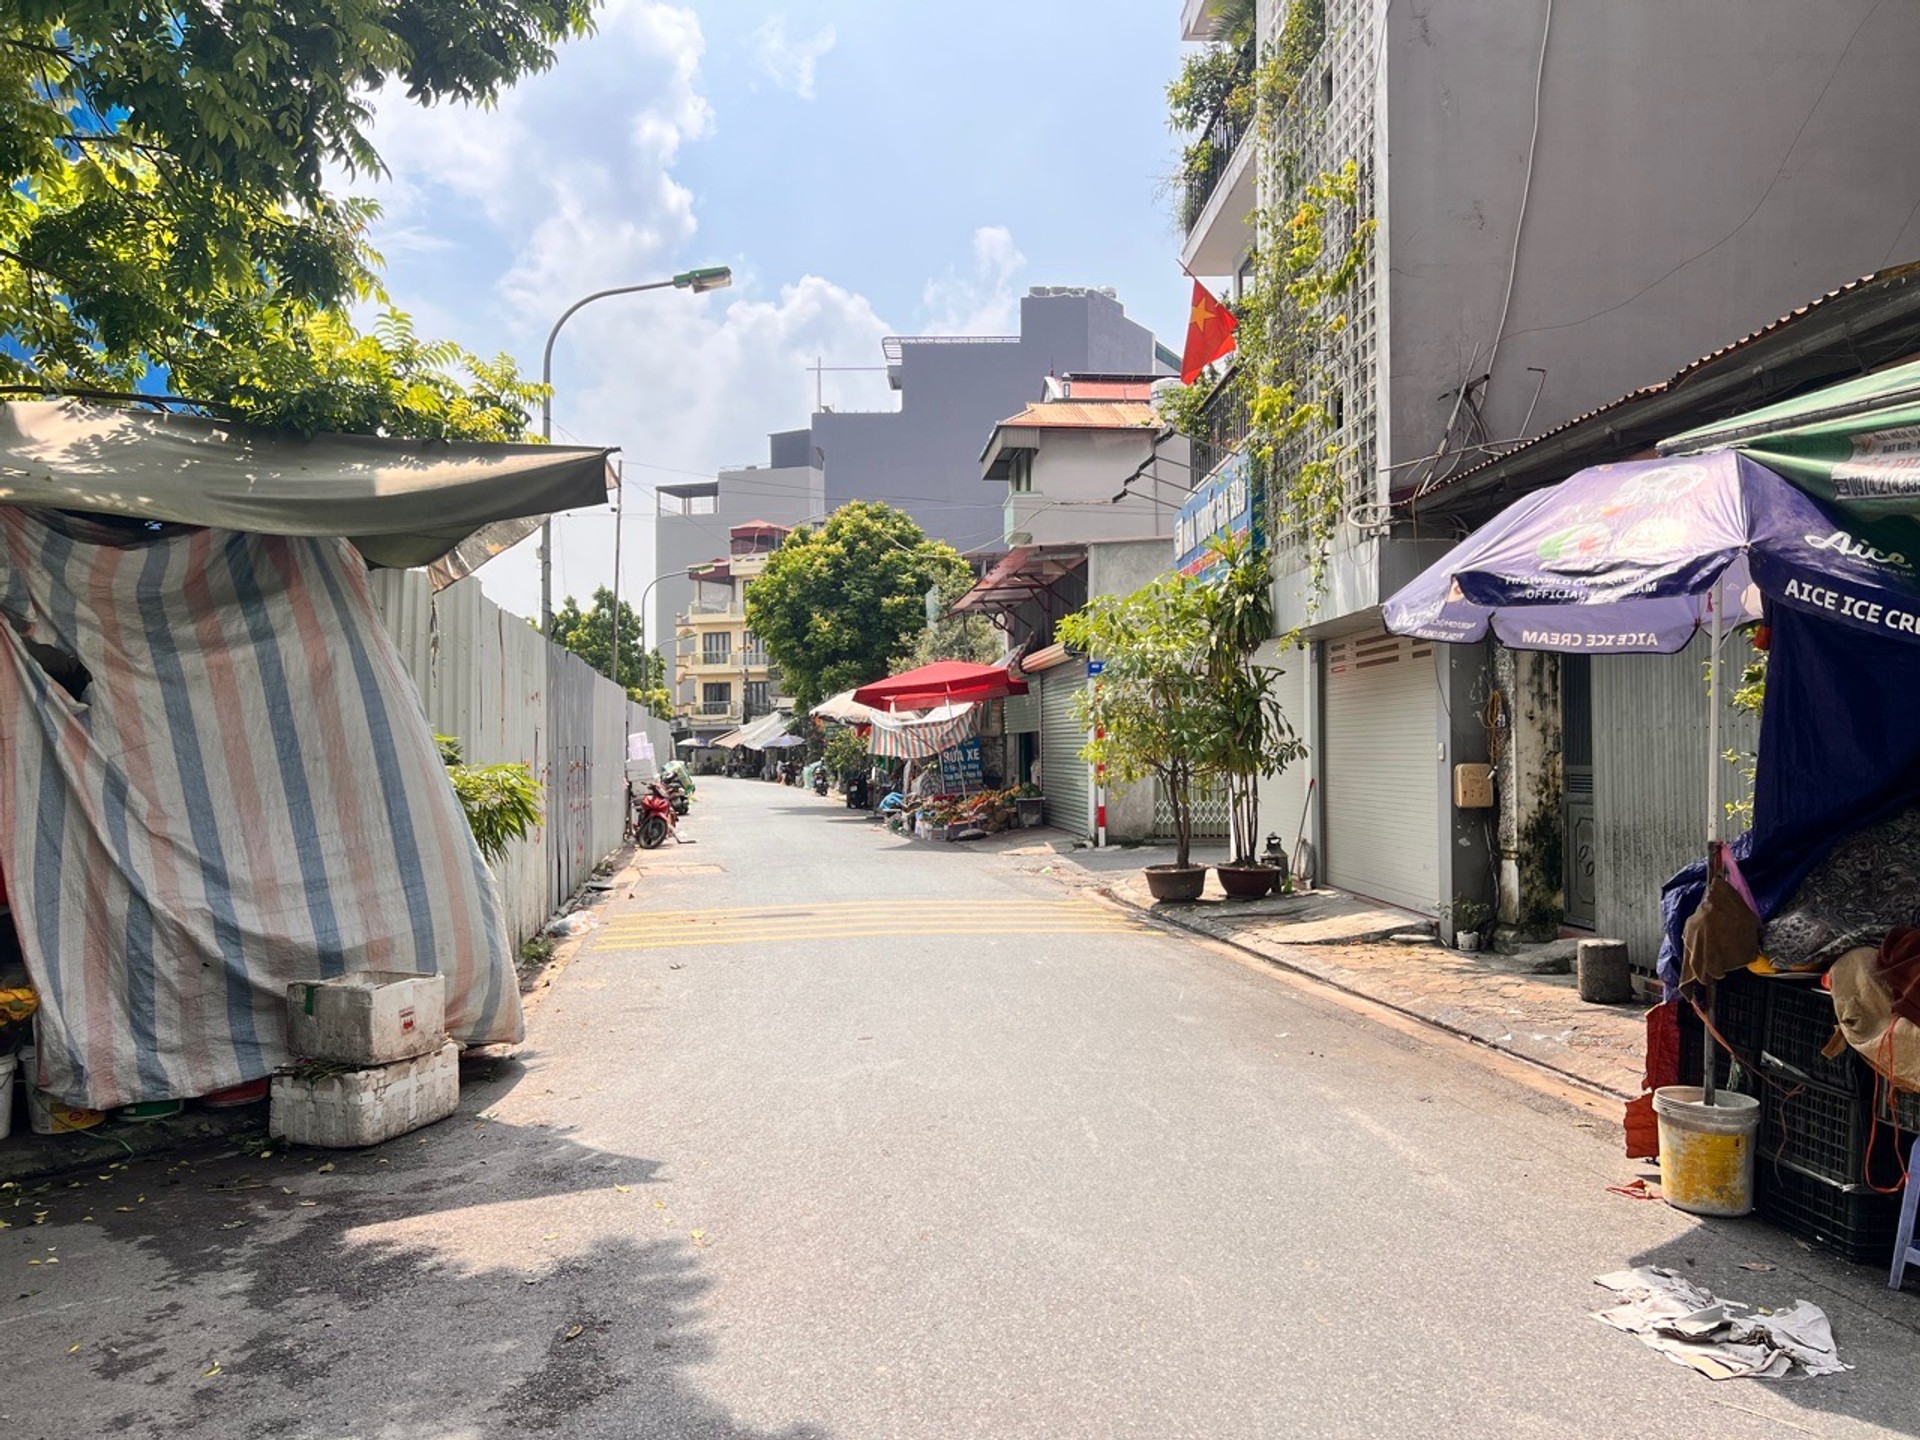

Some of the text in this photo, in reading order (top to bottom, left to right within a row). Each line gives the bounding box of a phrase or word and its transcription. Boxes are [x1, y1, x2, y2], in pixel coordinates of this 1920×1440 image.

[1804, 531, 1912, 568] Aice
[1784, 579, 1839, 610] AICE
[1840, 596, 1883, 624] ICE
[966, 748, 980, 761] XE
